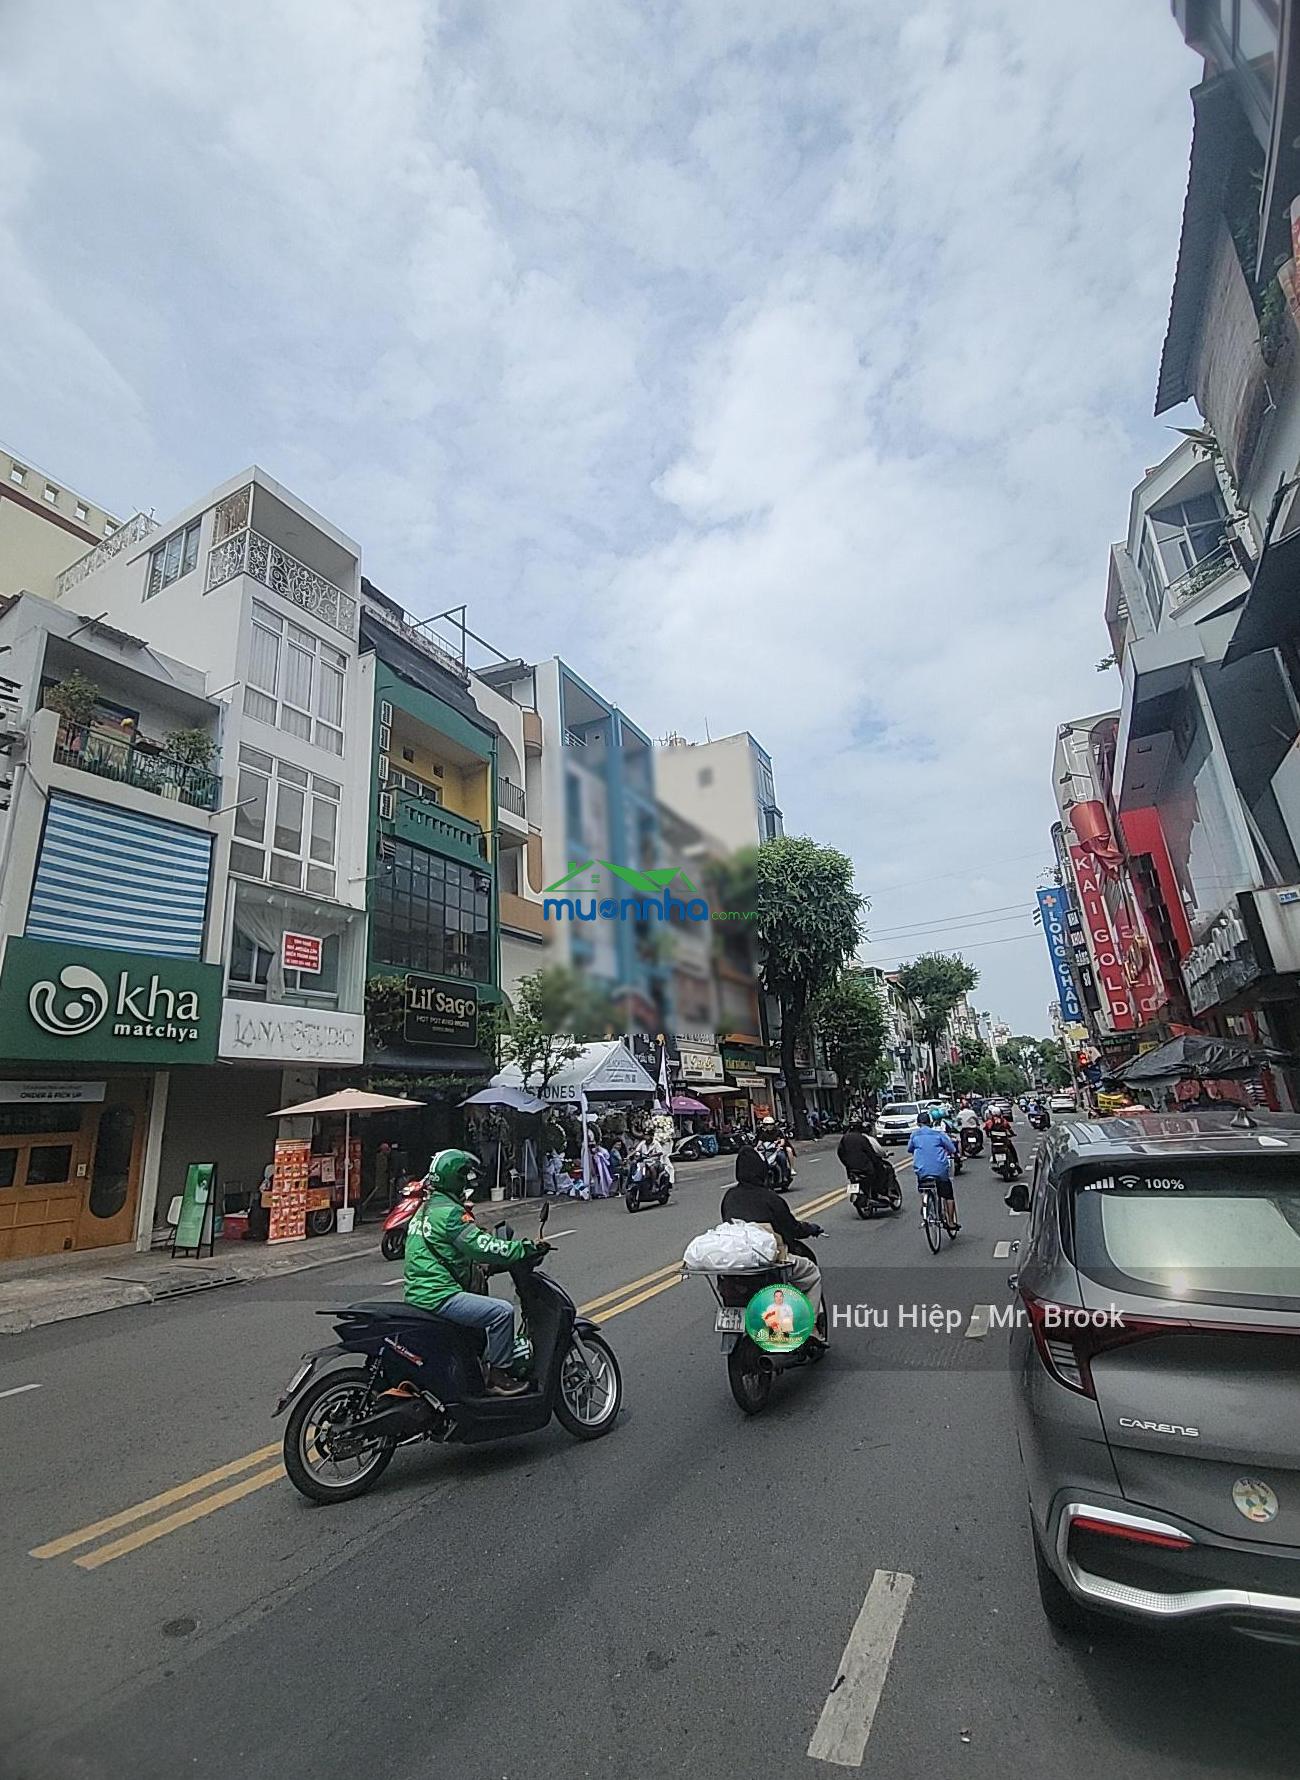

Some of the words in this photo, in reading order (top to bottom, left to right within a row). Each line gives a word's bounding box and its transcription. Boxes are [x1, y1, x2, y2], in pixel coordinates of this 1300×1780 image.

[1049, 912, 1066, 957] LONG
[1093, 929, 1129, 1016] GOLD
[116, 971, 200, 1022] kha
[435, 992, 476, 1018] Sago
[114, 1022, 199, 1043] matchya
[1144, 1178, 1185, 1191] 100%
[1119, 1417, 1199, 1437] CARENS
